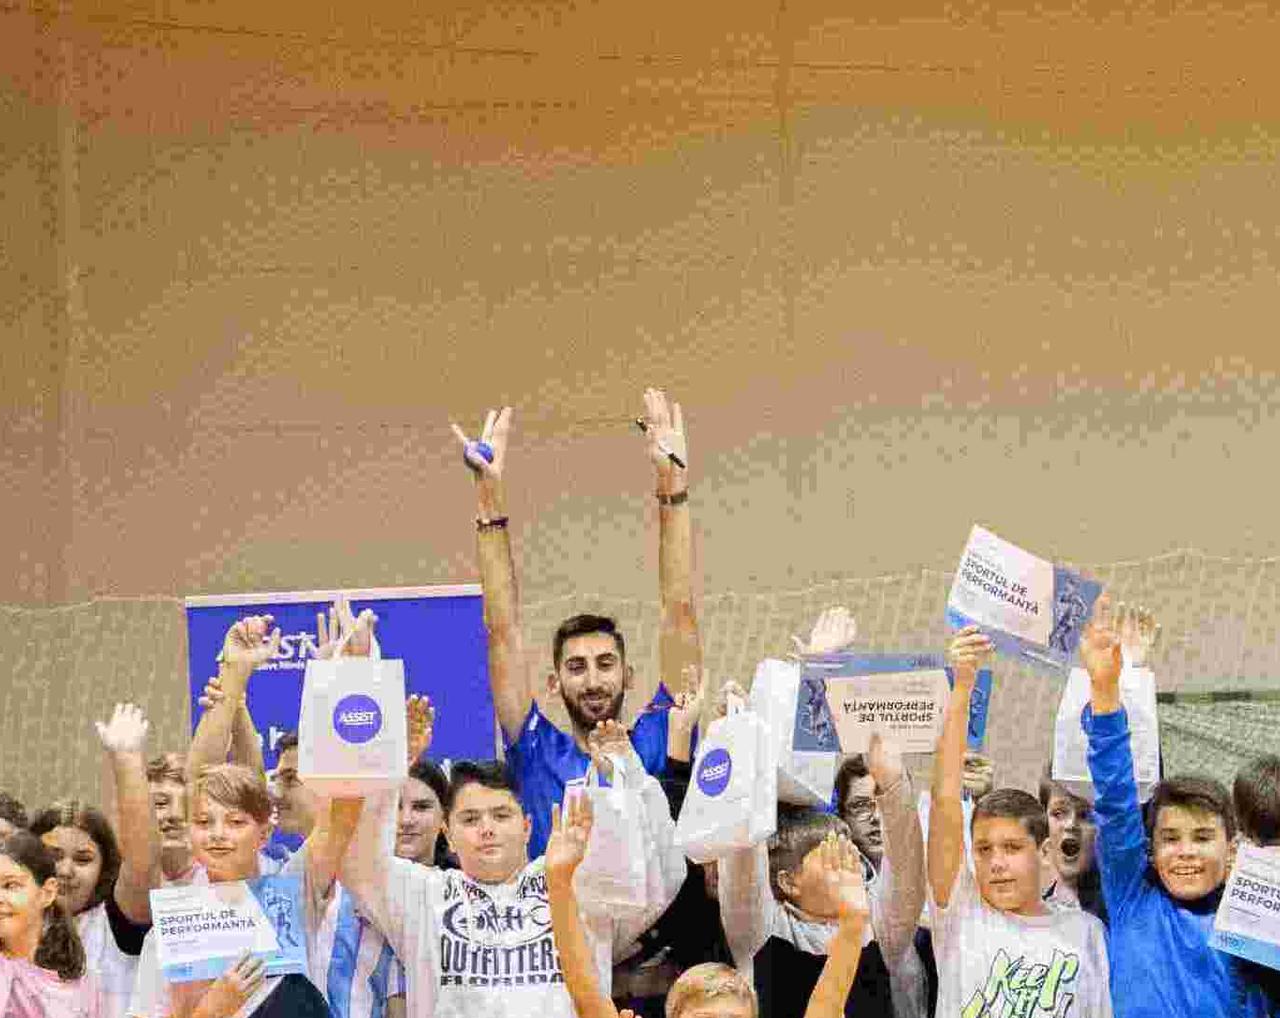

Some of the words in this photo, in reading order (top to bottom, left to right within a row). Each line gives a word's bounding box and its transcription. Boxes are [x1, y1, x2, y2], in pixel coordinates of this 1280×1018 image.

[159, 911, 216, 926] SPORTUL
[220, 909, 237, 919] DE
[440, 933, 561, 975] OUTFITTER
